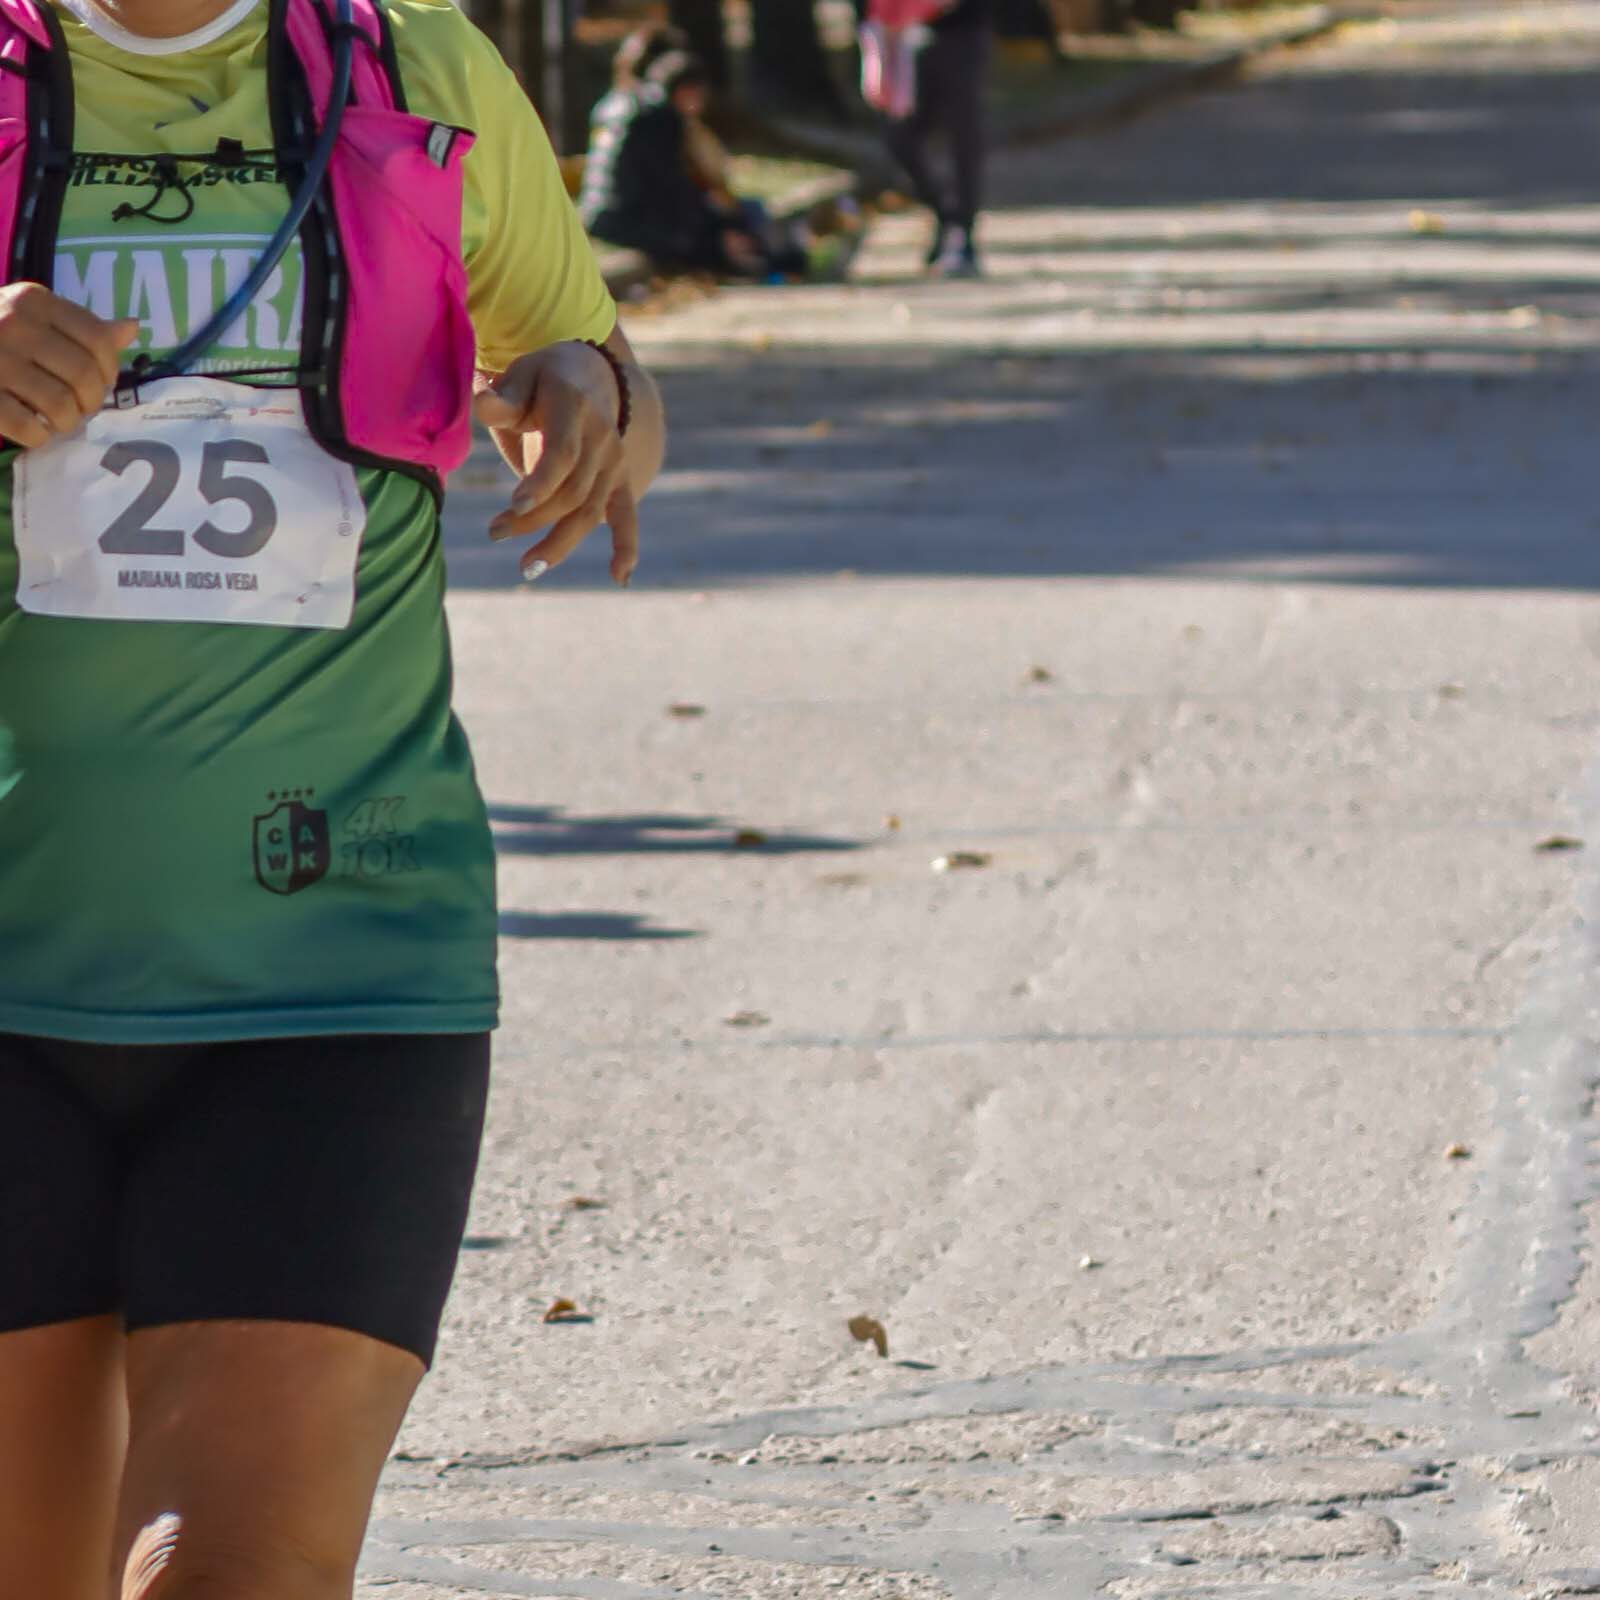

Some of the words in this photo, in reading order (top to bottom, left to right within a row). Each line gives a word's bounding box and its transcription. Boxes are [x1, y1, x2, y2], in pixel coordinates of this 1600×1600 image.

[53, 248, 303, 349] MAIR
[98, 438, 278, 558] 25
[117, 569, 182, 589] MARIANA
[184, 571, 222, 590] ROSA
[224, 572, 259, 591] VEGA
